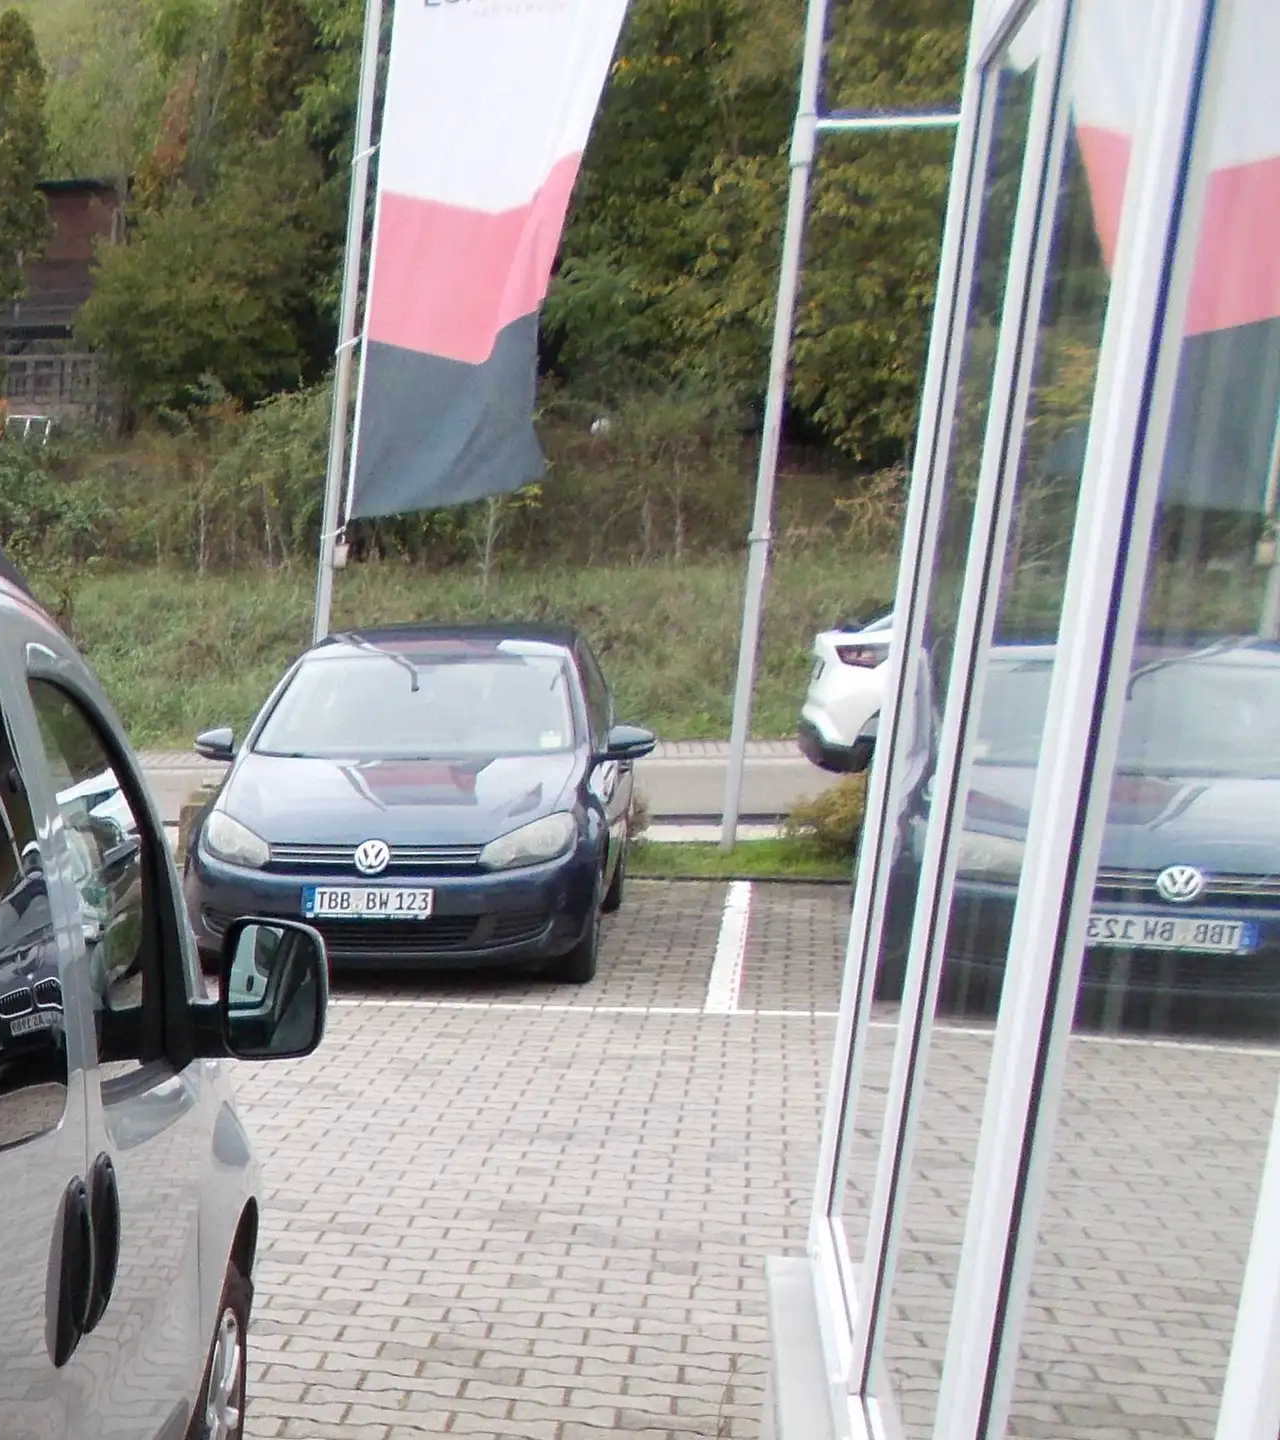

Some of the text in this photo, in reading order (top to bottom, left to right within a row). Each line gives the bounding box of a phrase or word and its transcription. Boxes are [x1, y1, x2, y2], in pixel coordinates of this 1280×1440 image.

[317, 891, 351, 910] TBB
[365, 892, 390, 910] BW
[394, 892, 429, 911] 123
